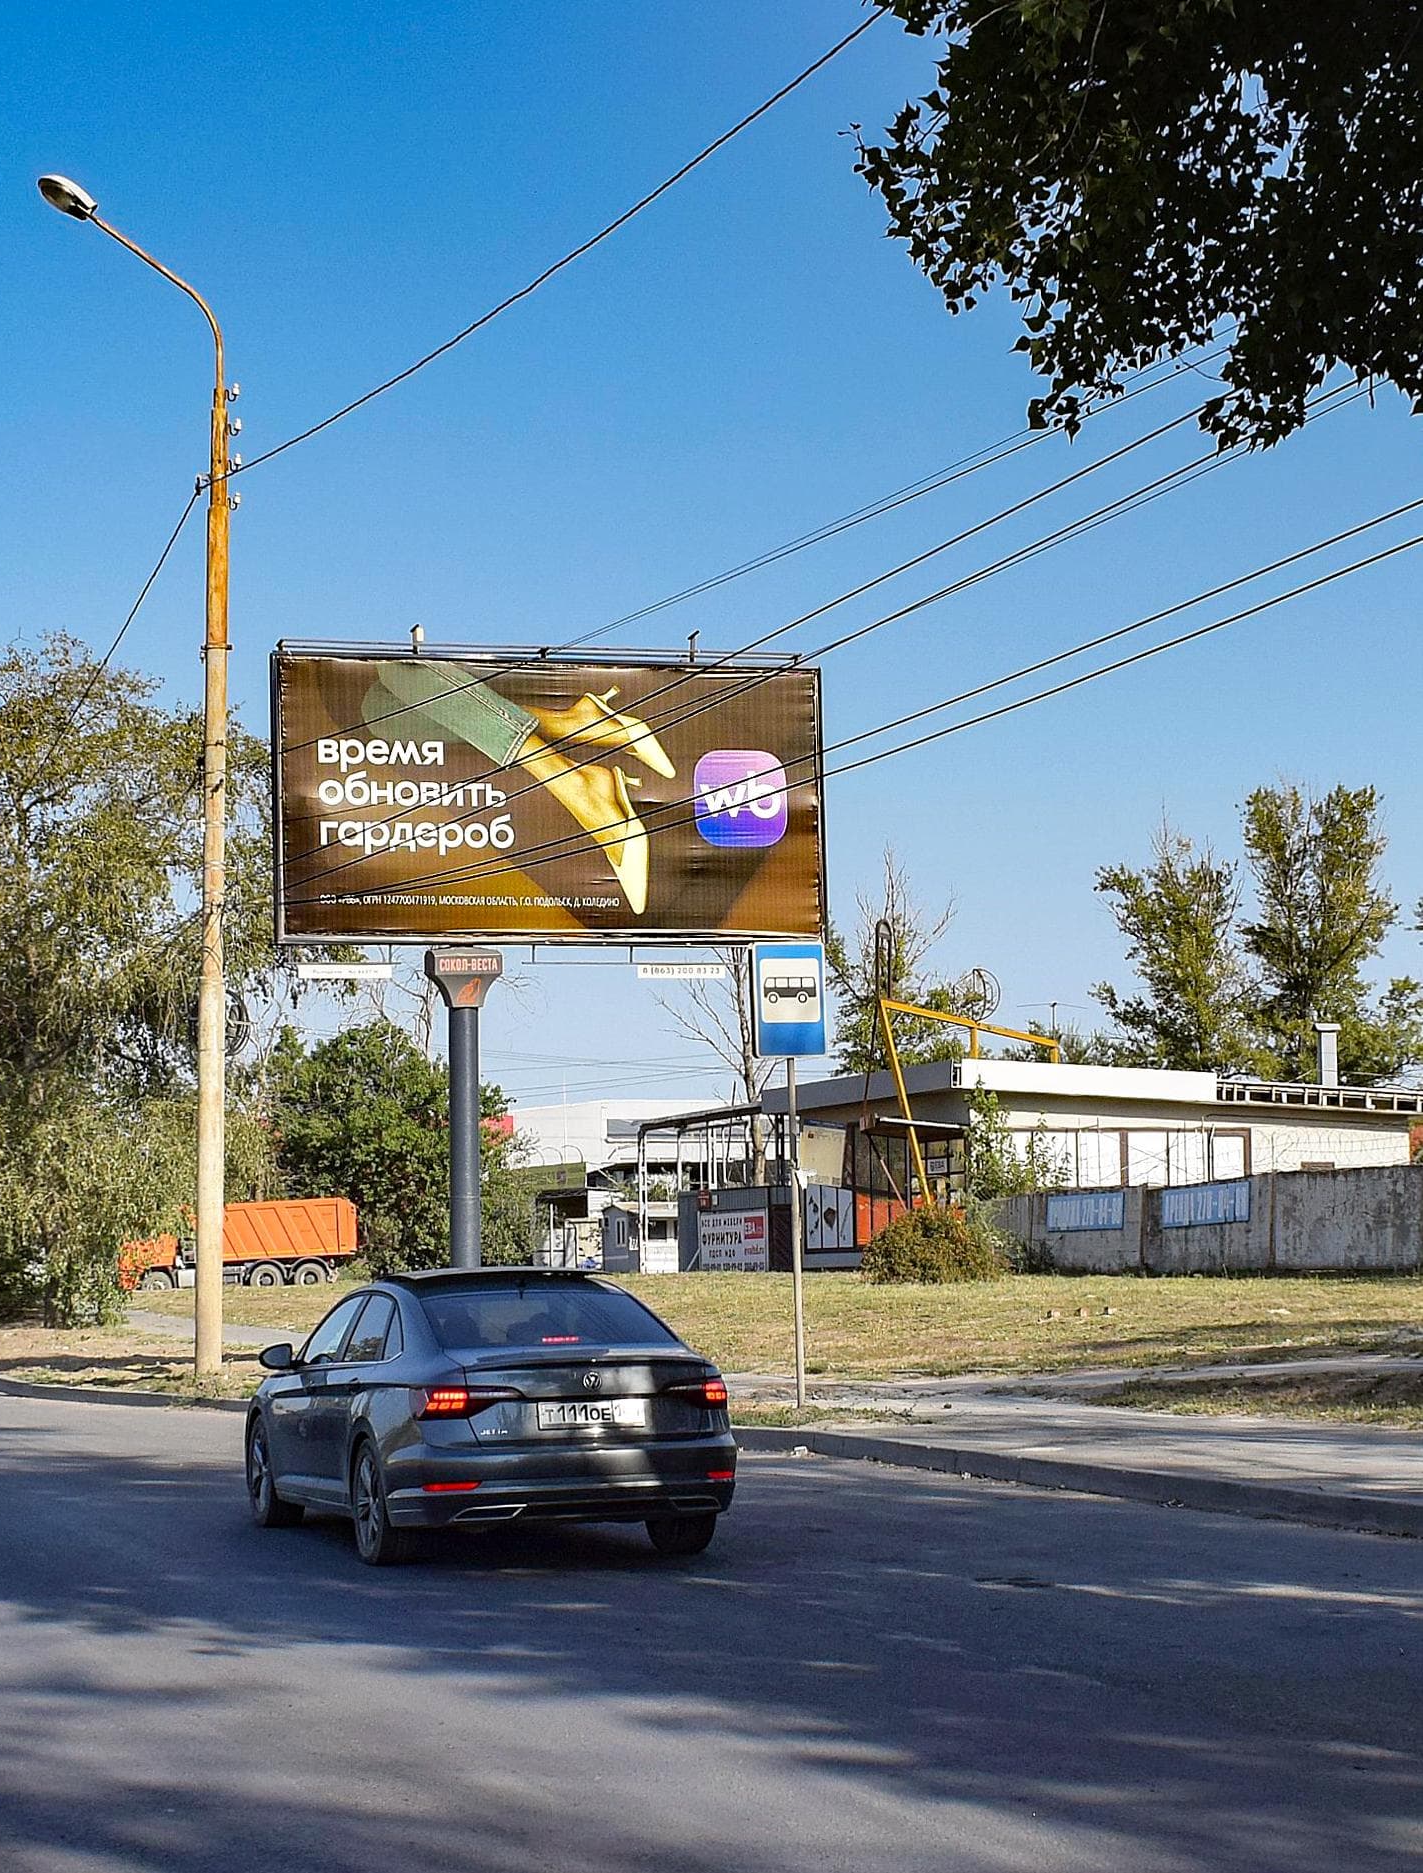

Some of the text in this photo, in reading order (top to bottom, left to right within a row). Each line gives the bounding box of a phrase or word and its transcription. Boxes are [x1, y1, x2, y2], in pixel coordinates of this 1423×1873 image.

[317, 738, 445, 773] время
[318, 770, 508, 808] обновить
[699, 770, 783, 820] wb
[319, 813, 516, 856] гардероб
[438, 957, 499, 972] СОКОЛ-ВЕСТА
[702, 1231, 742, 1246] ФУРНИТУРА
